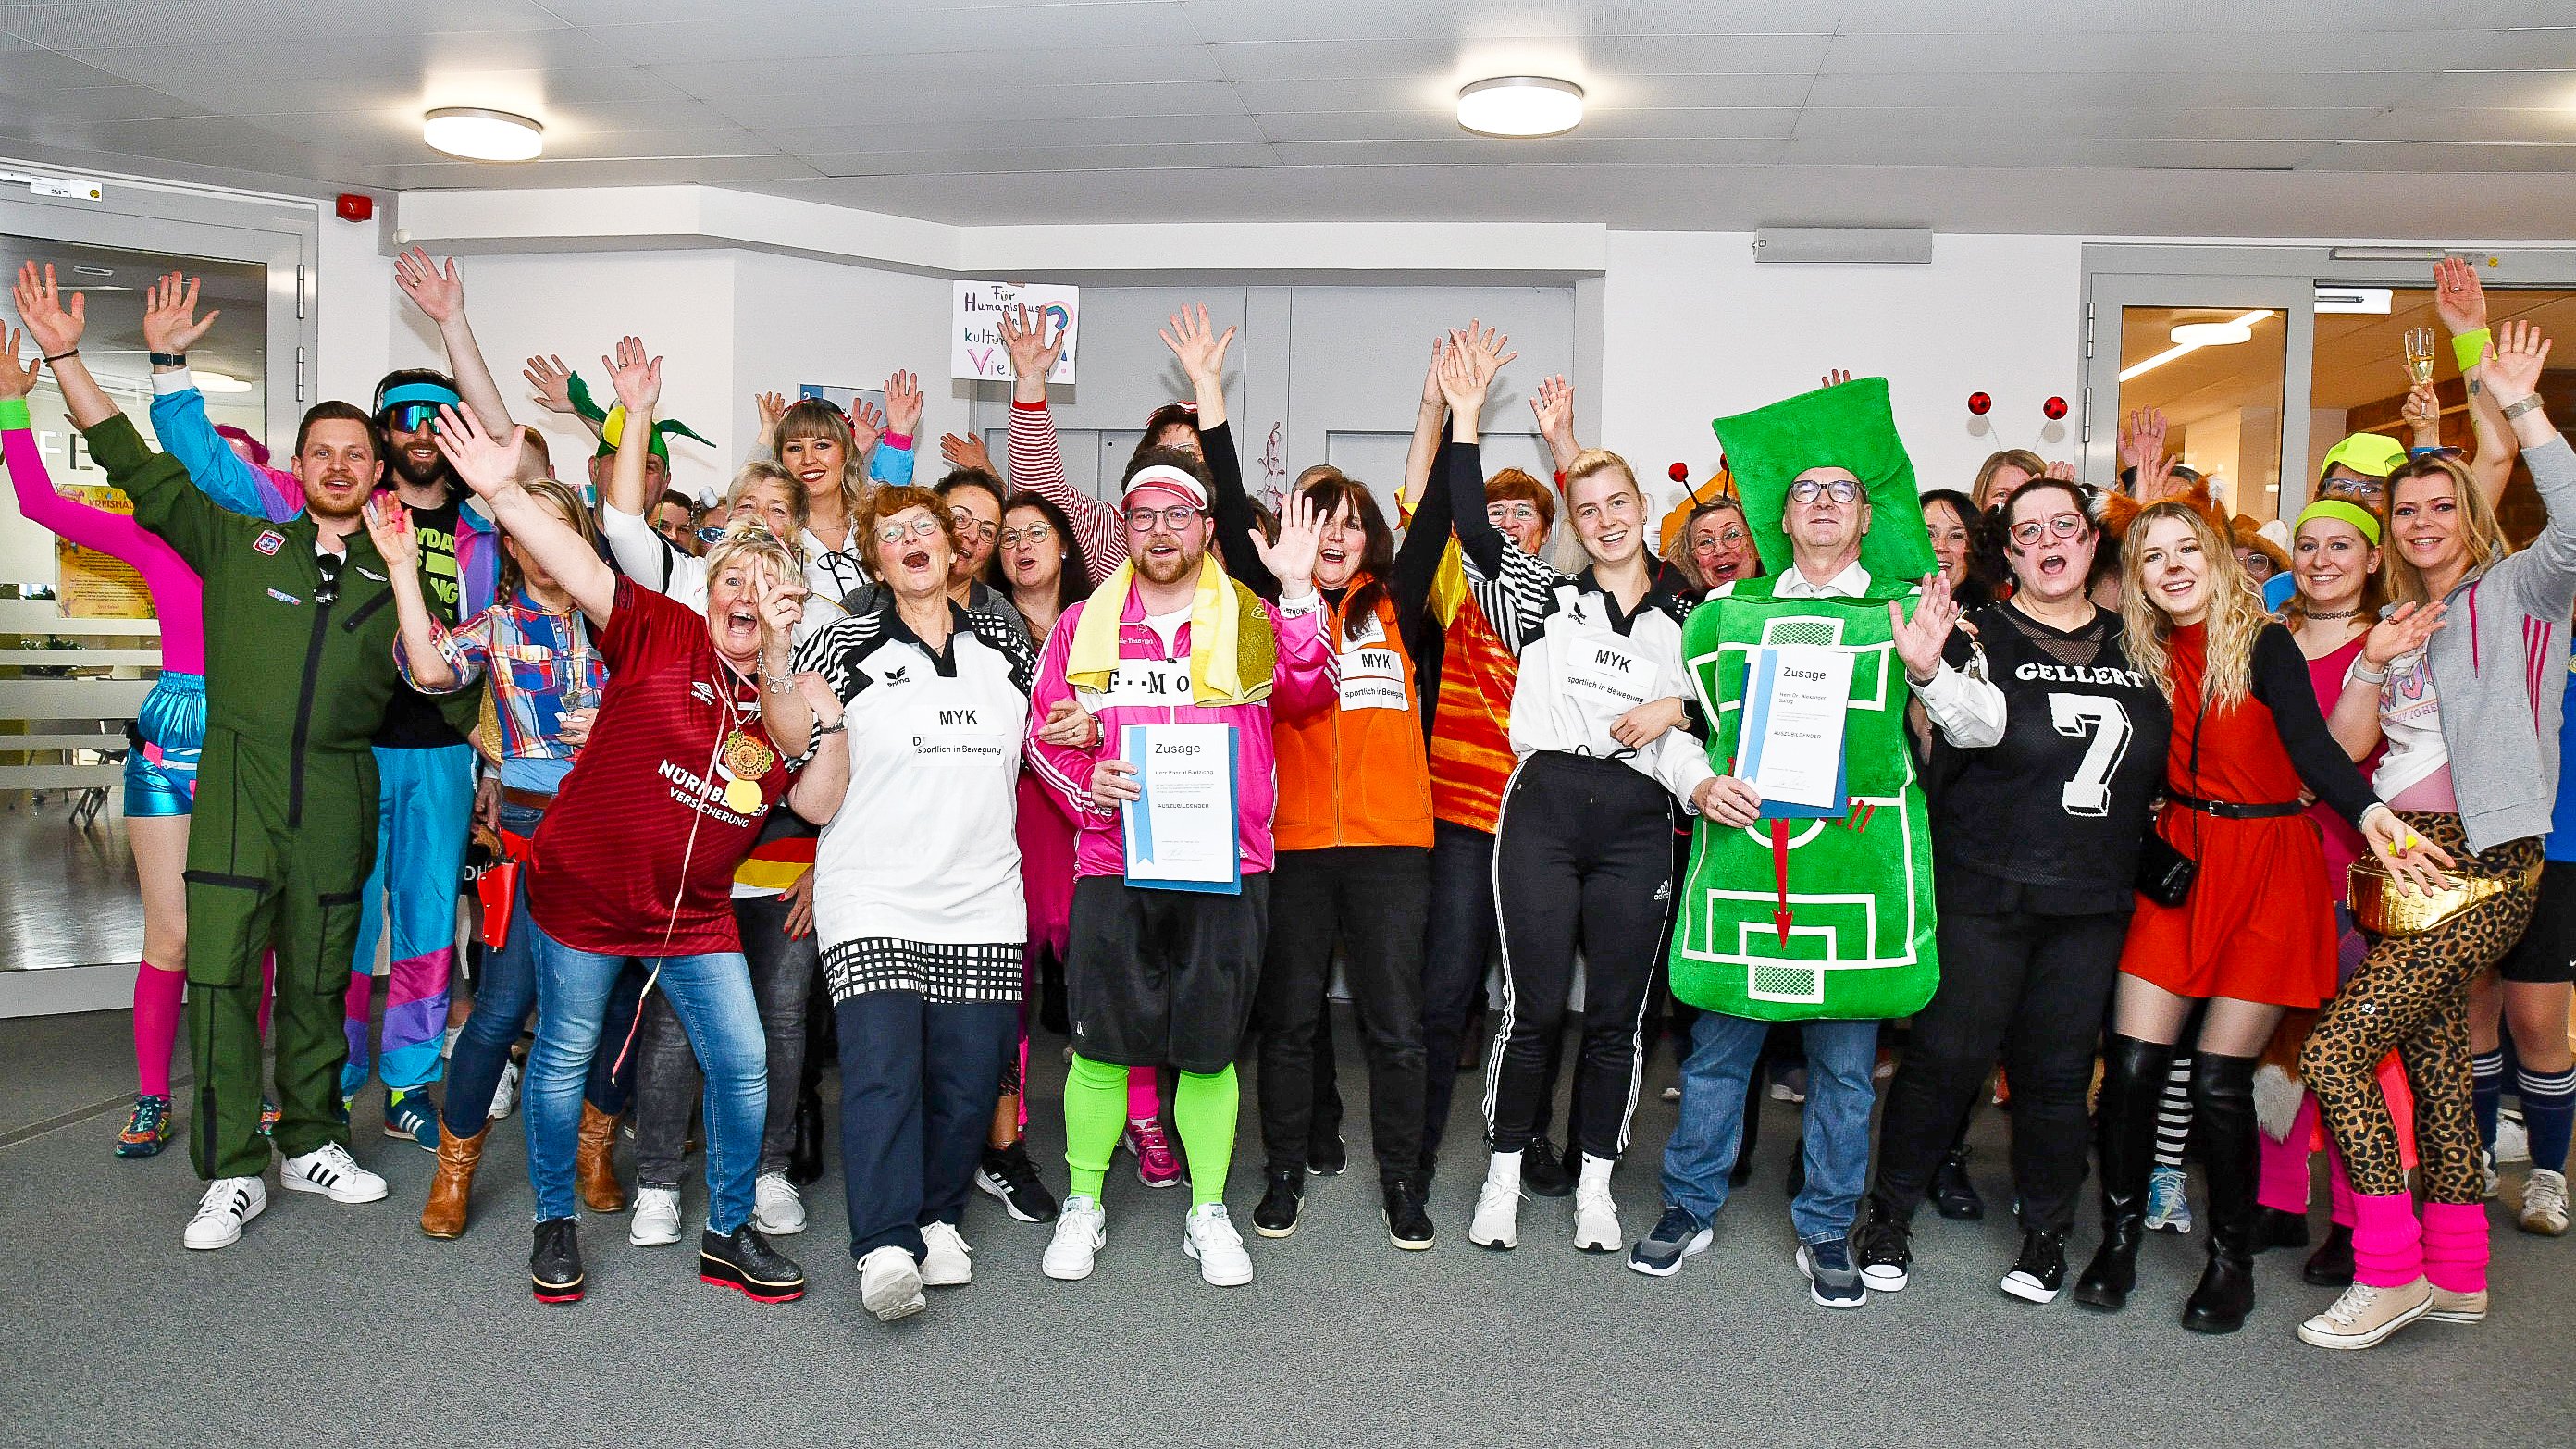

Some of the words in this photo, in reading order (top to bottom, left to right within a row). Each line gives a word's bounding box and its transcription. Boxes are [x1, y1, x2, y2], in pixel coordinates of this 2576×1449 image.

[964, 291, 1042, 313] Humanisus
[991, 285, 1016, 302] Für
[1361, 653, 1392, 670] MYK
[1594, 649, 1632, 674] MYK
[886, 677, 910, 687] erima
[1783, 666, 1827, 682] Zusage
[2015, 662, 2144, 688] GELLERT
[691, 690, 712, 706] umbro
[1344, 687, 1376, 700] sportlich
[1567, 676, 1597, 689] sportlich
[1598, 683, 1606, 692] in
[1606, 686, 1644, 705] Bewegung
[938, 710, 979, 726] MYK
[917, 745, 952, 756] sportlich
[961, 745, 1002, 756] Bewegung
[1155, 743, 1201, 756] Zusage
[2047, 692, 2133, 817] 7
[669, 786, 749, 828] VERSICHERUNG
